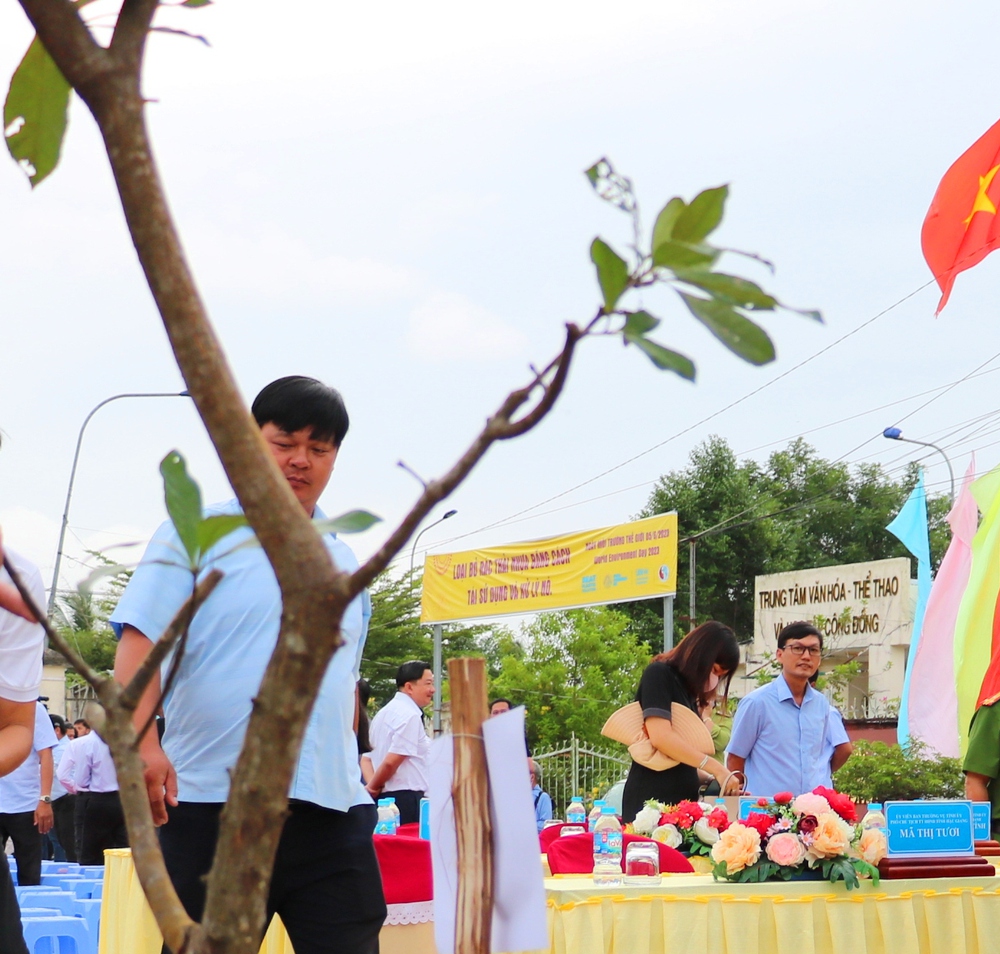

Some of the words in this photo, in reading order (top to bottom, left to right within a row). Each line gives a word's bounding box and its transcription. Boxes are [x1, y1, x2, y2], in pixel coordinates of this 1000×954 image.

[453, 562, 467, 582] LOẠI
[479, 557, 492, 576] RÁC
[495, 553, 509, 574] THẢI
[551, 546, 570, 566] CÁCH
[609, 549, 637, 562] Environment
[638, 548, 647, 557] Day
[648, 546, 660, 556] 2023
[468, 586, 477, 605] TÁI
[490, 585, 507, 605] DỤNG
[760, 590, 786, 609] TRUNG
[788, 583, 806, 606] TÂM
[809, 581, 826, 603] VĂN
[827, 578, 846, 601] HÓA
[853, 570, 871, 599] THỂ
[873, 576, 899, 597] THAO
[900, 827, 915, 838] MÃ
[917, 828, 933, 839] THỊ
[936, 827, 960, 837] TƯƠI
